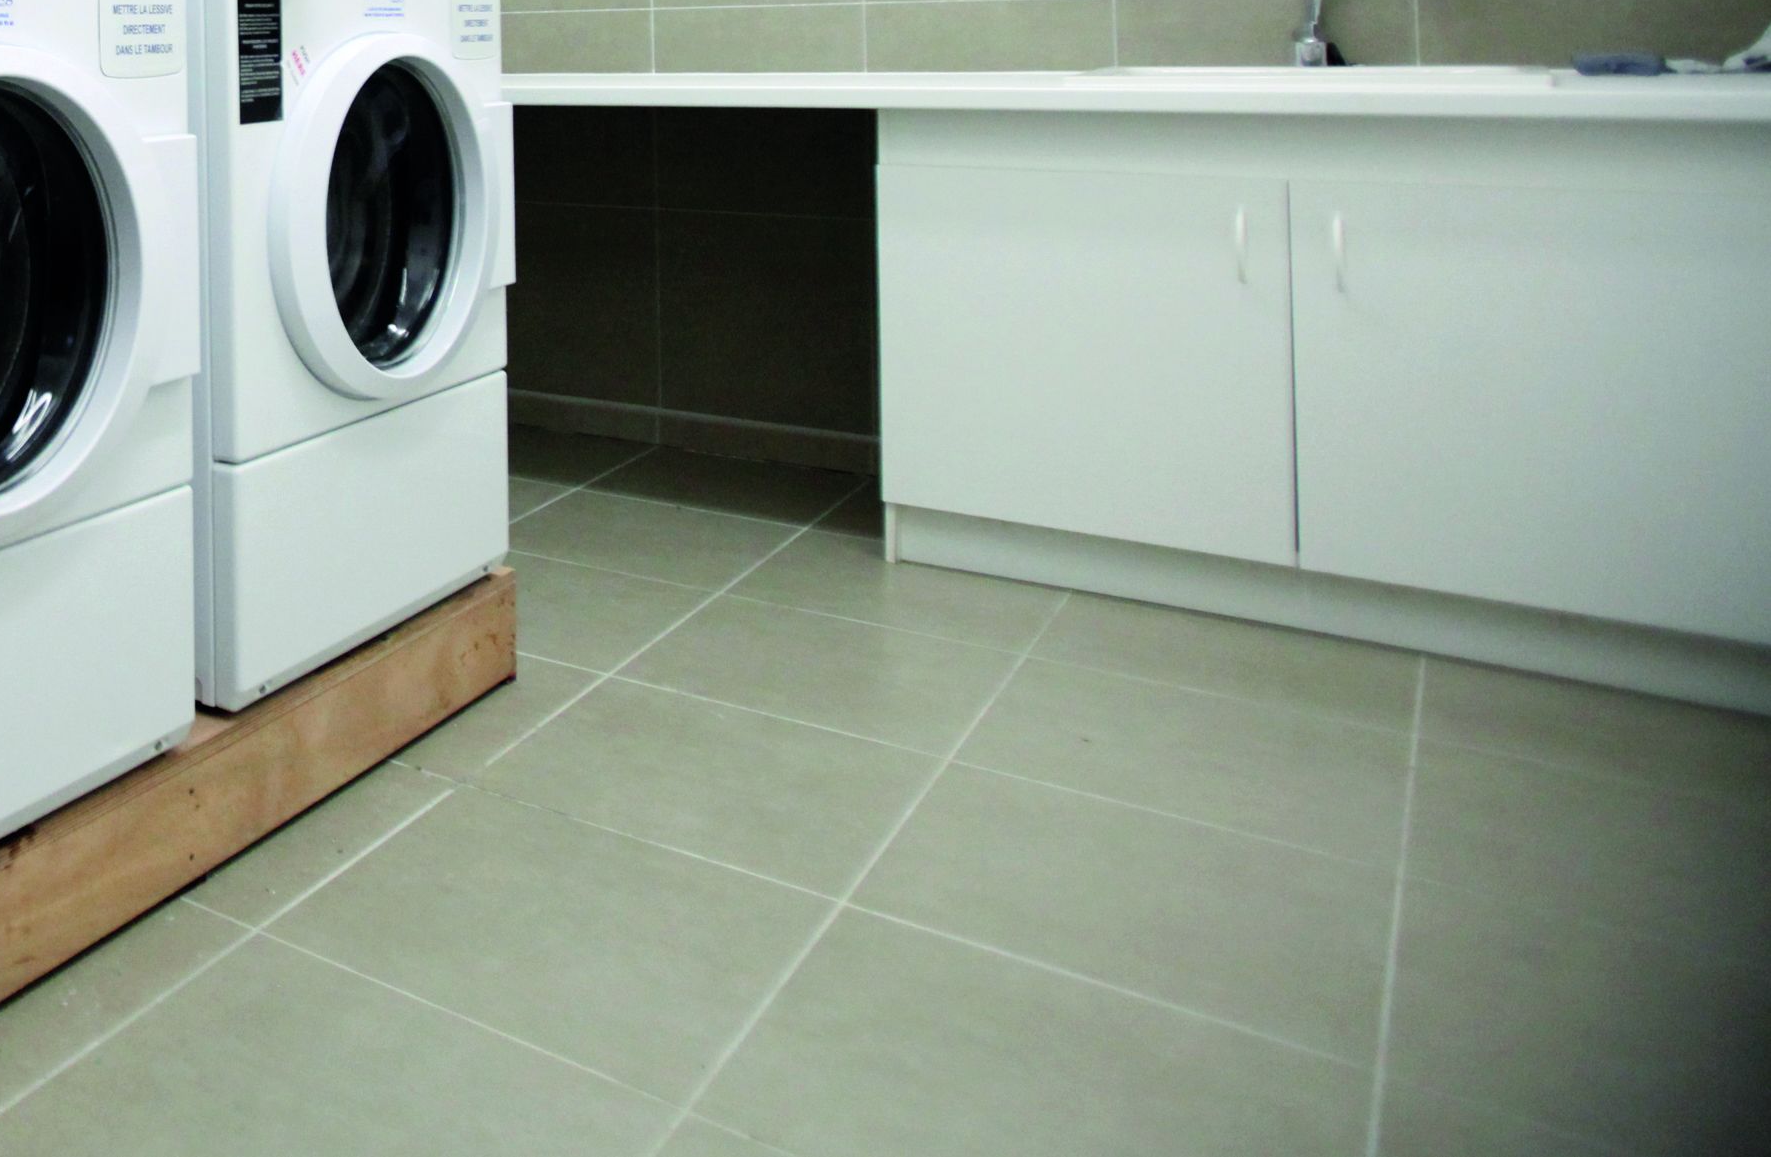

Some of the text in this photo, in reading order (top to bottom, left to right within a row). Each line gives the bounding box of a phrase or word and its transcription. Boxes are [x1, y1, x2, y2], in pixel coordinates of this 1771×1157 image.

[112, 4, 172, 15] METTRE LA LESSIVE
[123, 24, 166, 35] DIRECTEMENT
[116, 44, 172, 56] DANS LE TAMBOUR
